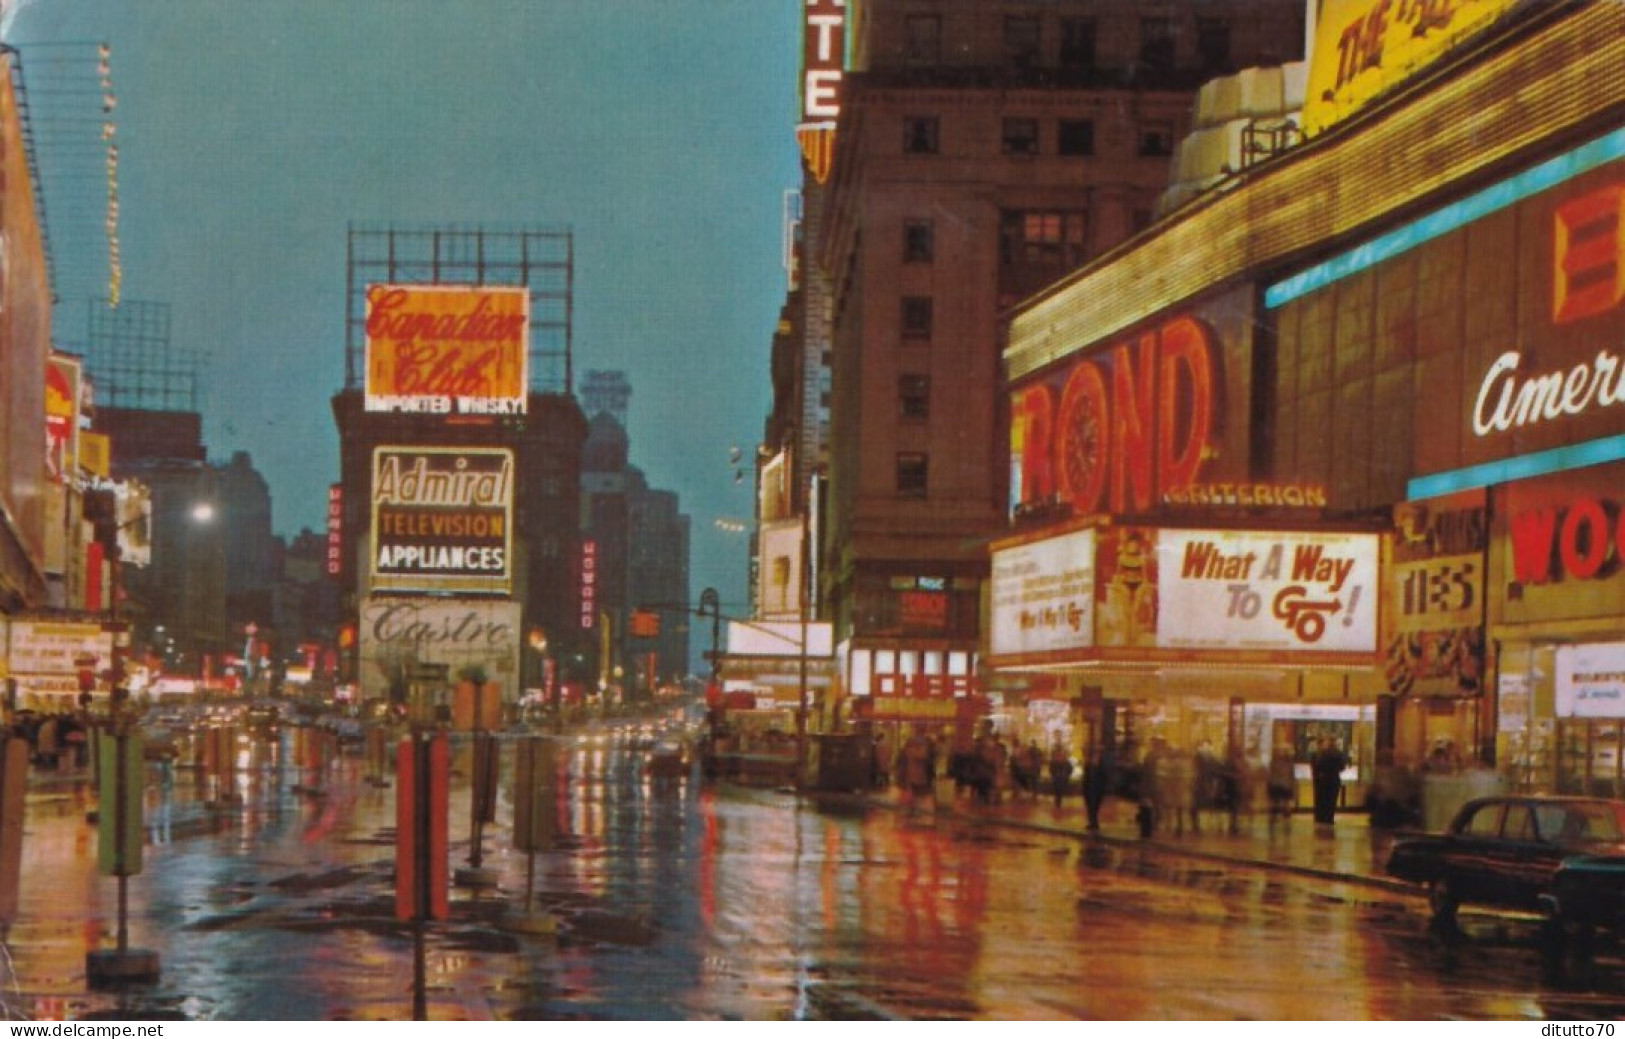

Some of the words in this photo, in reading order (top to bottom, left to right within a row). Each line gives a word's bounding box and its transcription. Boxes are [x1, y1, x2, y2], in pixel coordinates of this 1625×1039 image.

[805, 0, 843, 116] TE
[366, 285, 526, 340] Canadian
[395, 343, 498, 395] Club
[376, 456, 512, 506] Admiral
[381, 512, 503, 537] TELEVISION
[1511, 497, 1625, 586] WO
[378, 546, 503, 570] APPLIANCES
[1181, 541, 1255, 580] What
[1259, 543, 1284, 580] A
[1291, 545, 1355, 592] Way
[364, 604, 513, 644] Castro
